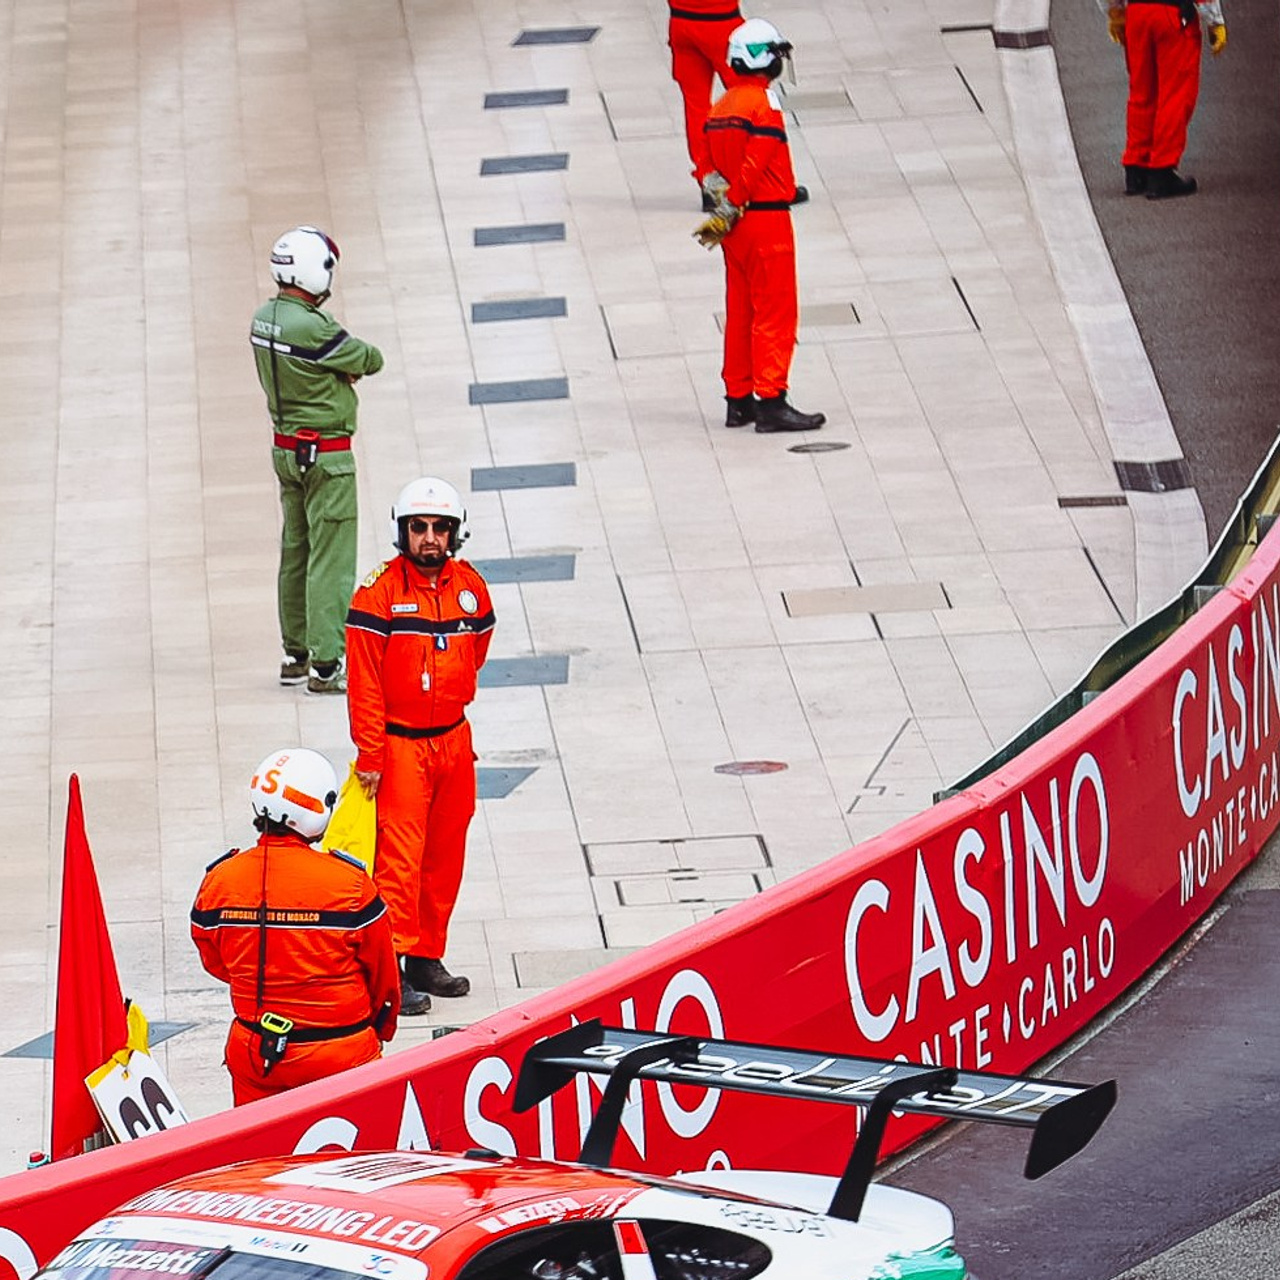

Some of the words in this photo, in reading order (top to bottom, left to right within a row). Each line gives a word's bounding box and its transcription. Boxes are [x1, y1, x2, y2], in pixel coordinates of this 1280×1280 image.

[843, 751, 1110, 1043] CASINO
[1179, 786, 1247, 907] MONTE
[1019, 917, 1115, 1040] CARLO
[75, 1241, 210, 1274] Mezzetti
[359, 1216, 441, 1250] LED
